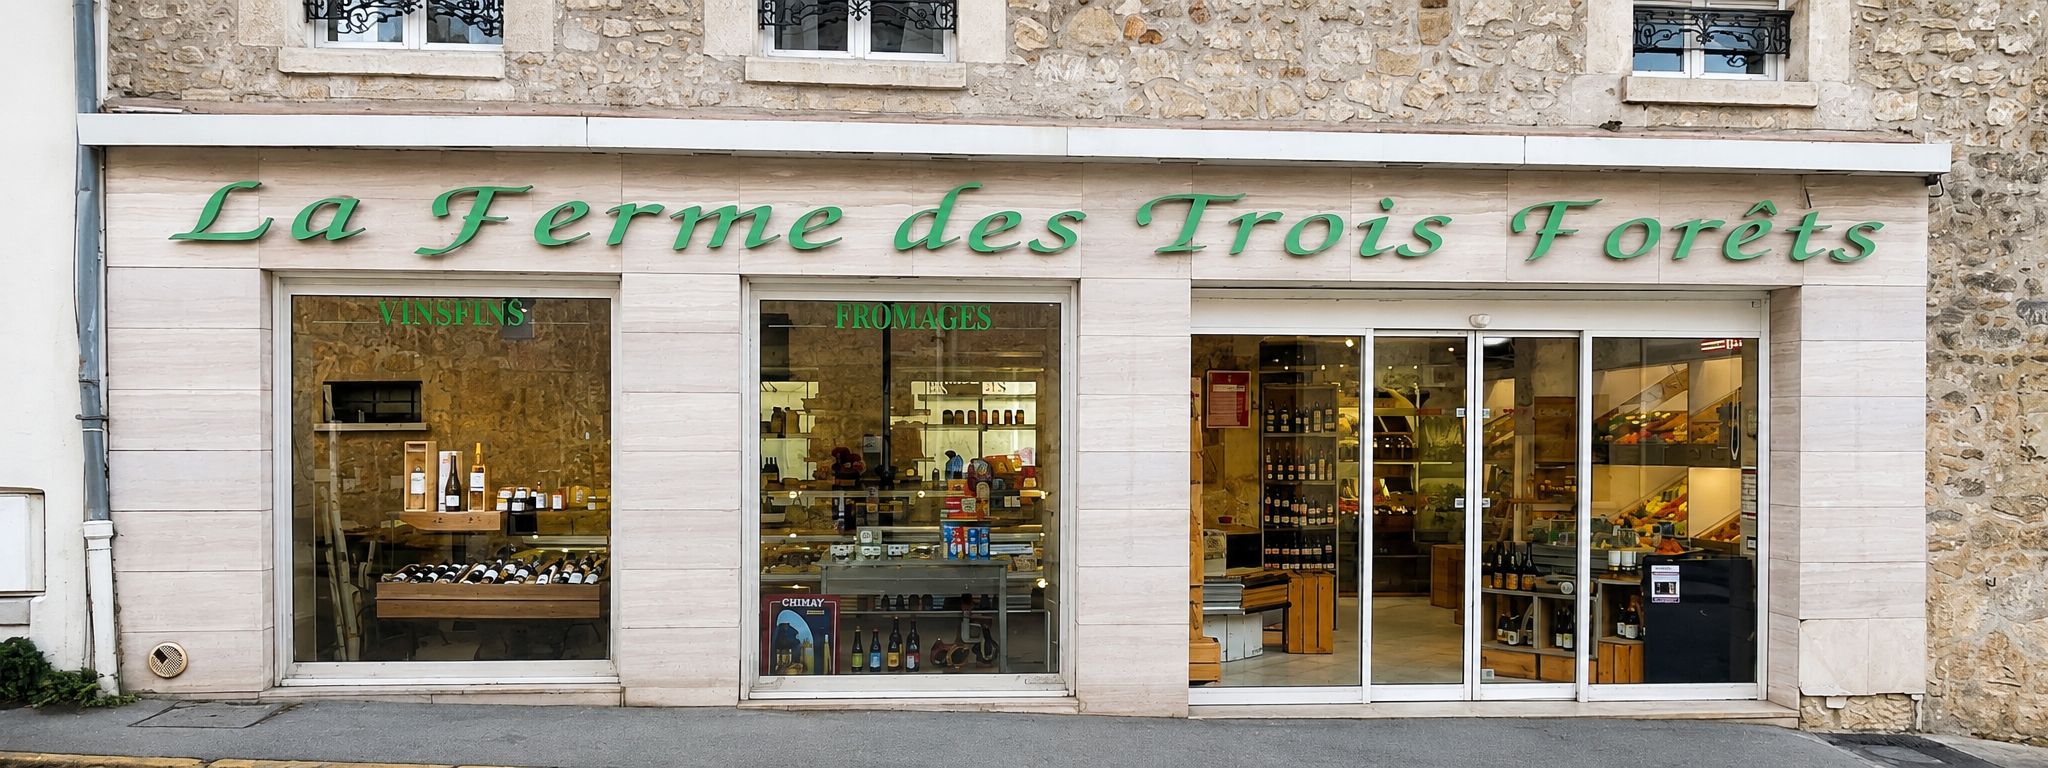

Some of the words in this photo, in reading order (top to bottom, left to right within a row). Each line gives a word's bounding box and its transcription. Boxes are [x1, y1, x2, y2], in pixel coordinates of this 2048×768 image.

[168, 181, 366, 243] La
[414, 184, 843, 256] Ferme
[893, 181, 1087, 254] des
[1135, 192, 1453, 258] Trois
[1510, 198, 1885, 264] Forêts
[834, 302, 992, 331] FROMAGES
[782, 598, 825, 608] CHIMAY
